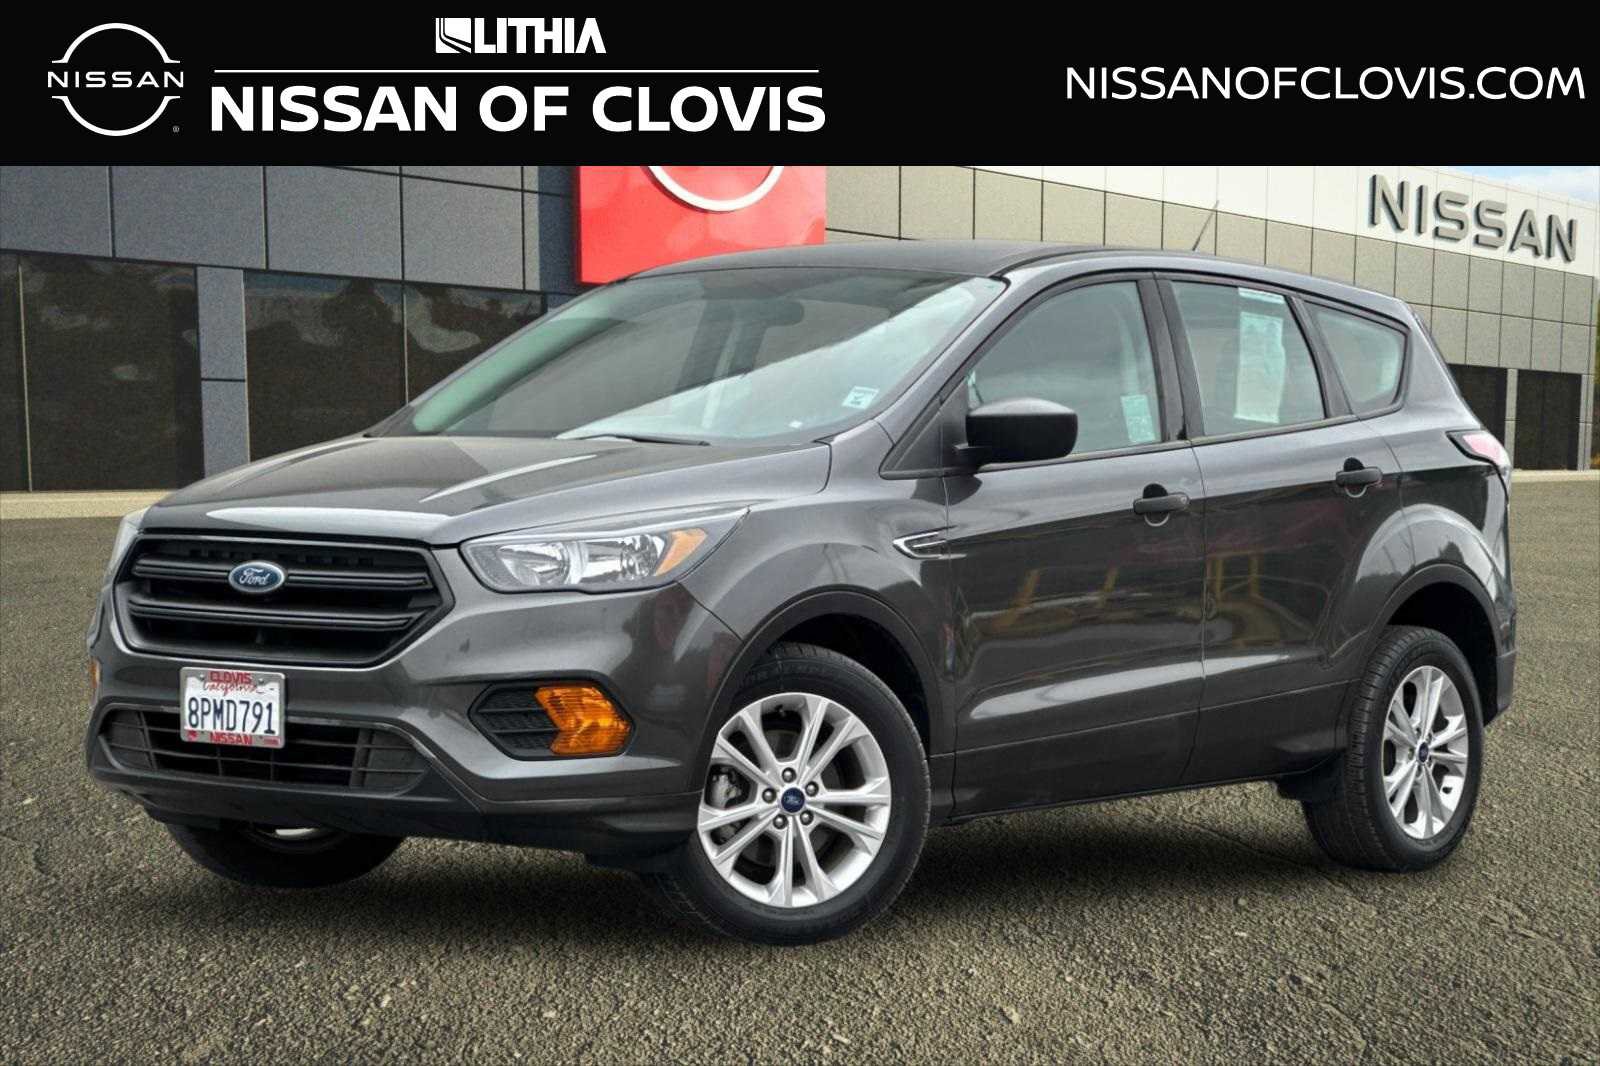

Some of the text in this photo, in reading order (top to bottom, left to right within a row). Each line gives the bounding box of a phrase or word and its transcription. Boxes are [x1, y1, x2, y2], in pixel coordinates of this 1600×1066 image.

[1369, 174, 1577, 263] NISSAN
[239, 567, 271, 585] Ford
[210, 671, 252, 684] CLOVIS
[188, 697, 276, 735] 8PMD791
[210, 731, 253, 745] NISSAN
